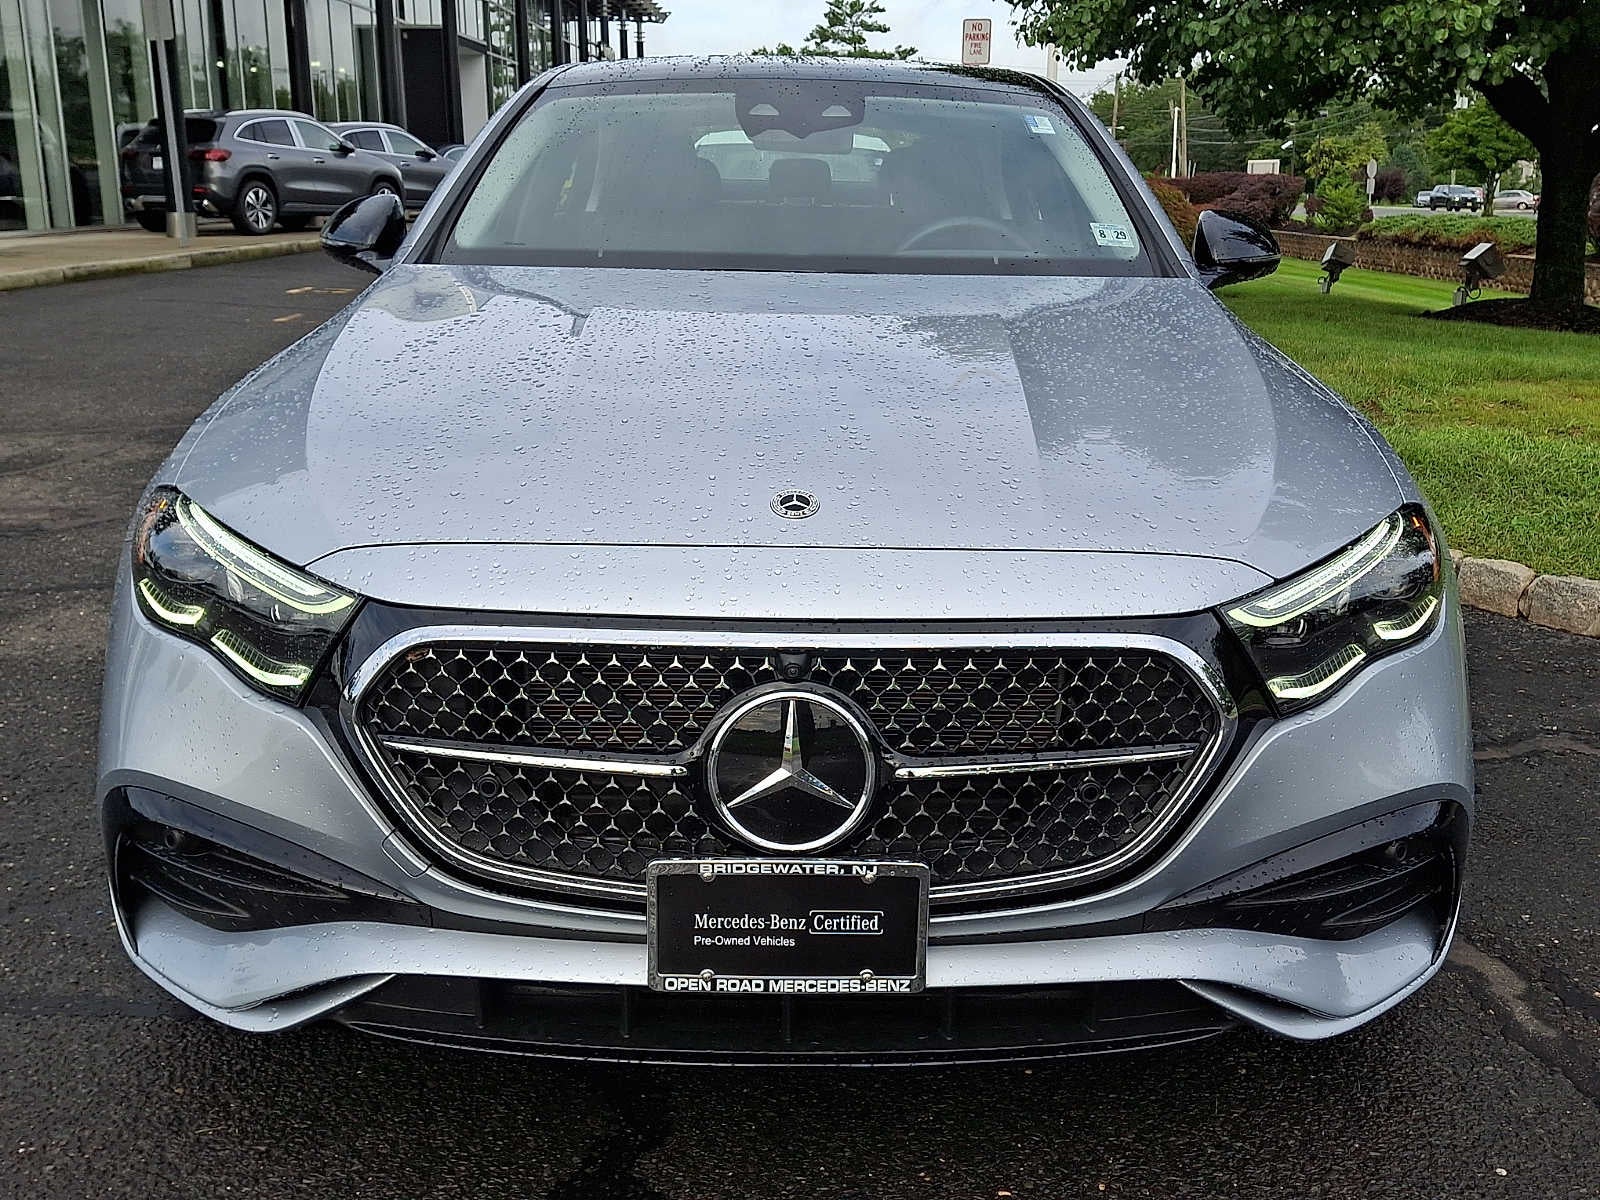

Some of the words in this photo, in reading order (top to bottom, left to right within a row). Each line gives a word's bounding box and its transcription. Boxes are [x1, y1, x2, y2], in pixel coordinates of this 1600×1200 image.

[972, 22, 983, 31] NO
[1098, 229, 1106, 238] 8
[1113, 230, 1127, 239] 29
[699, 863, 844, 875] BRIDGEWATER,
[852, 865, 878, 876] NJ
[694, 913, 806, 930] Mercedes-Benz
[813, 914, 879, 931] Certified
[694, 935, 750, 946] Pre-Owned
[753, 936, 795, 947] Vehicles
[664, 978, 711, 991] OPEN
[716, 979, 764, 992] ROAD
[769, 979, 910, 993] MERCEDES-BENZ
